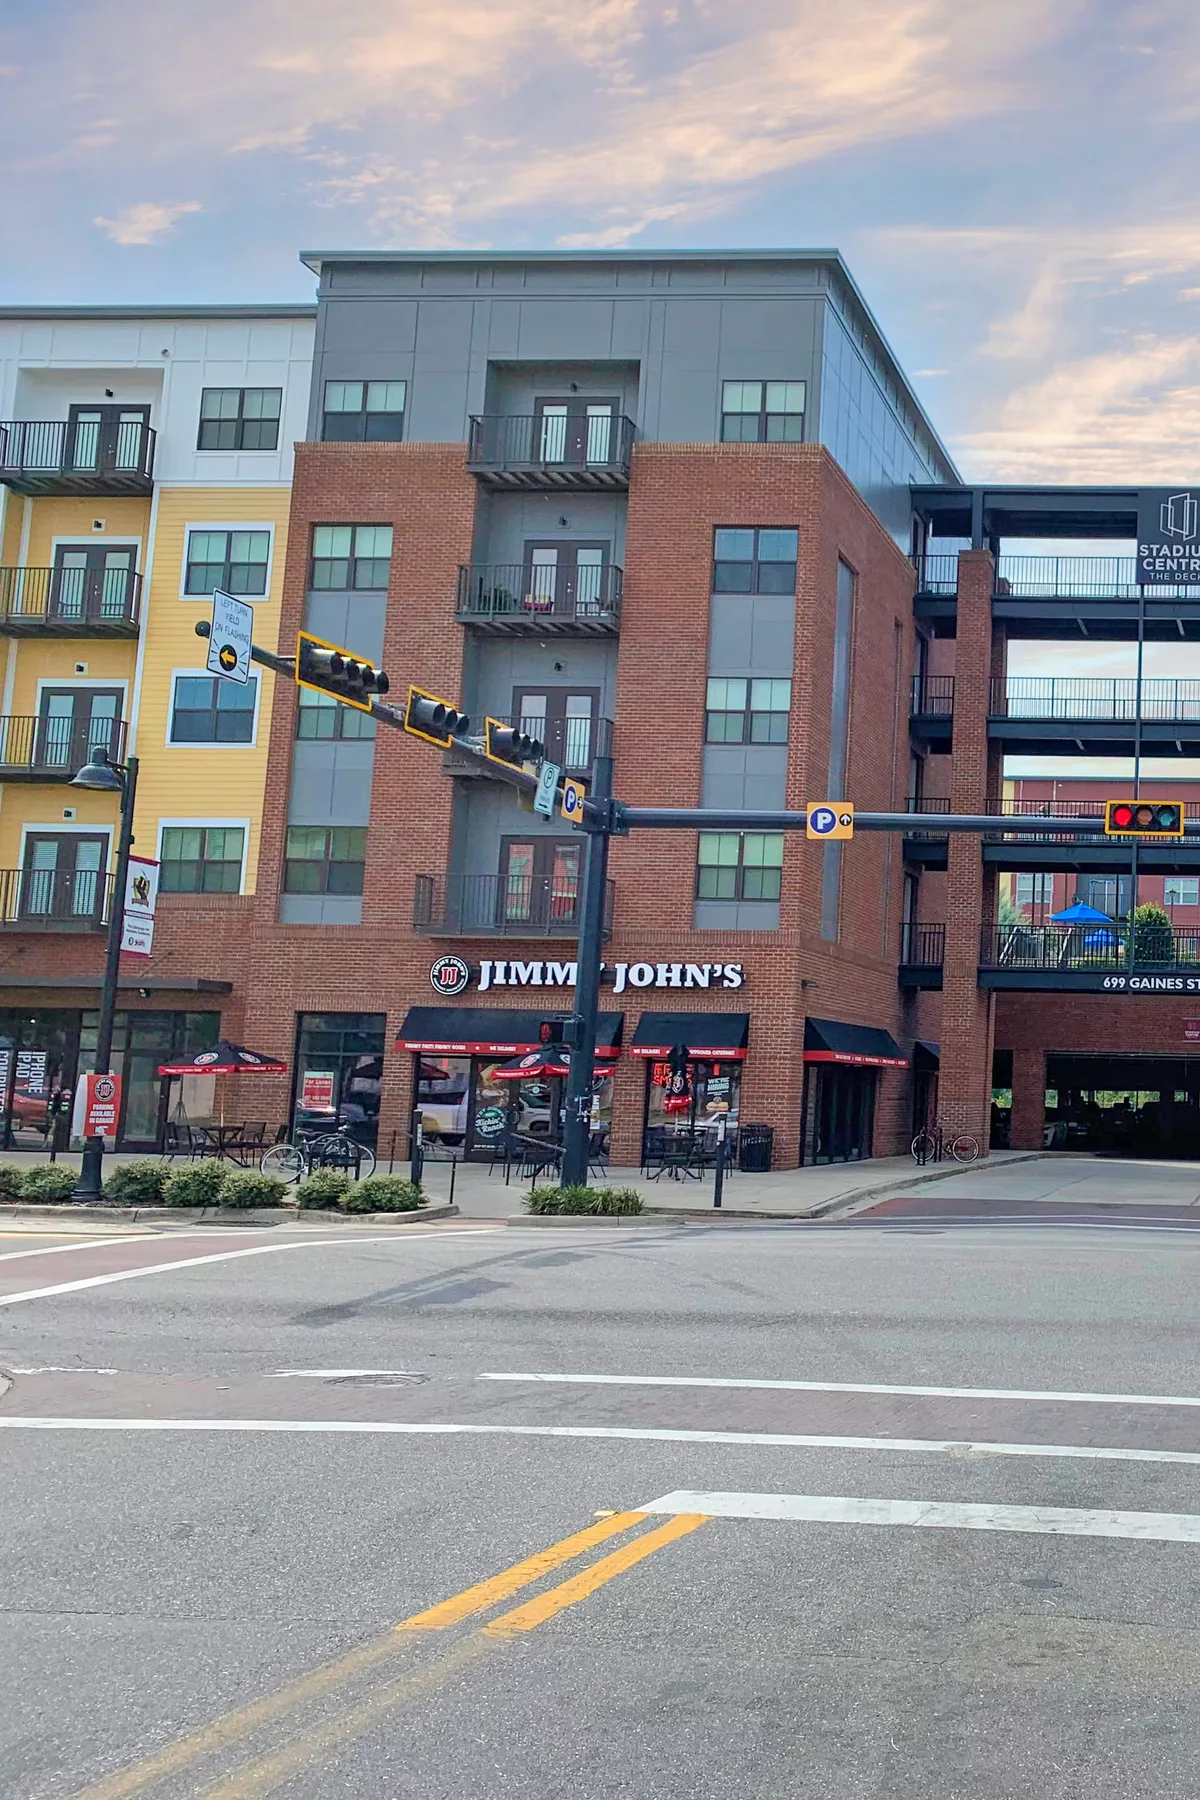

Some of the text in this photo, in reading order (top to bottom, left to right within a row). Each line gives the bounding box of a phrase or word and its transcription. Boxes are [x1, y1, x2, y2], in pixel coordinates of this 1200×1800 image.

[1150, 572, 1170, 580] THE
[220, 598, 248, 617] LEFT TURN
[225, 612, 240, 625] YIELD
[214, 622, 250, 645] ON FLASHING
[817, 812, 833, 830] P
[440, 967, 458, 985] JJ
[477, 961, 605, 991] JIMM
[612, 962, 743, 993] JOHN'S
[1103, 977, 1126, 988] 699
[1129, 977, 1183, 989] GAINES
[16, 1051, 32, 1078] IPAD
[28, 1051, 46, 1093] IPHONE
